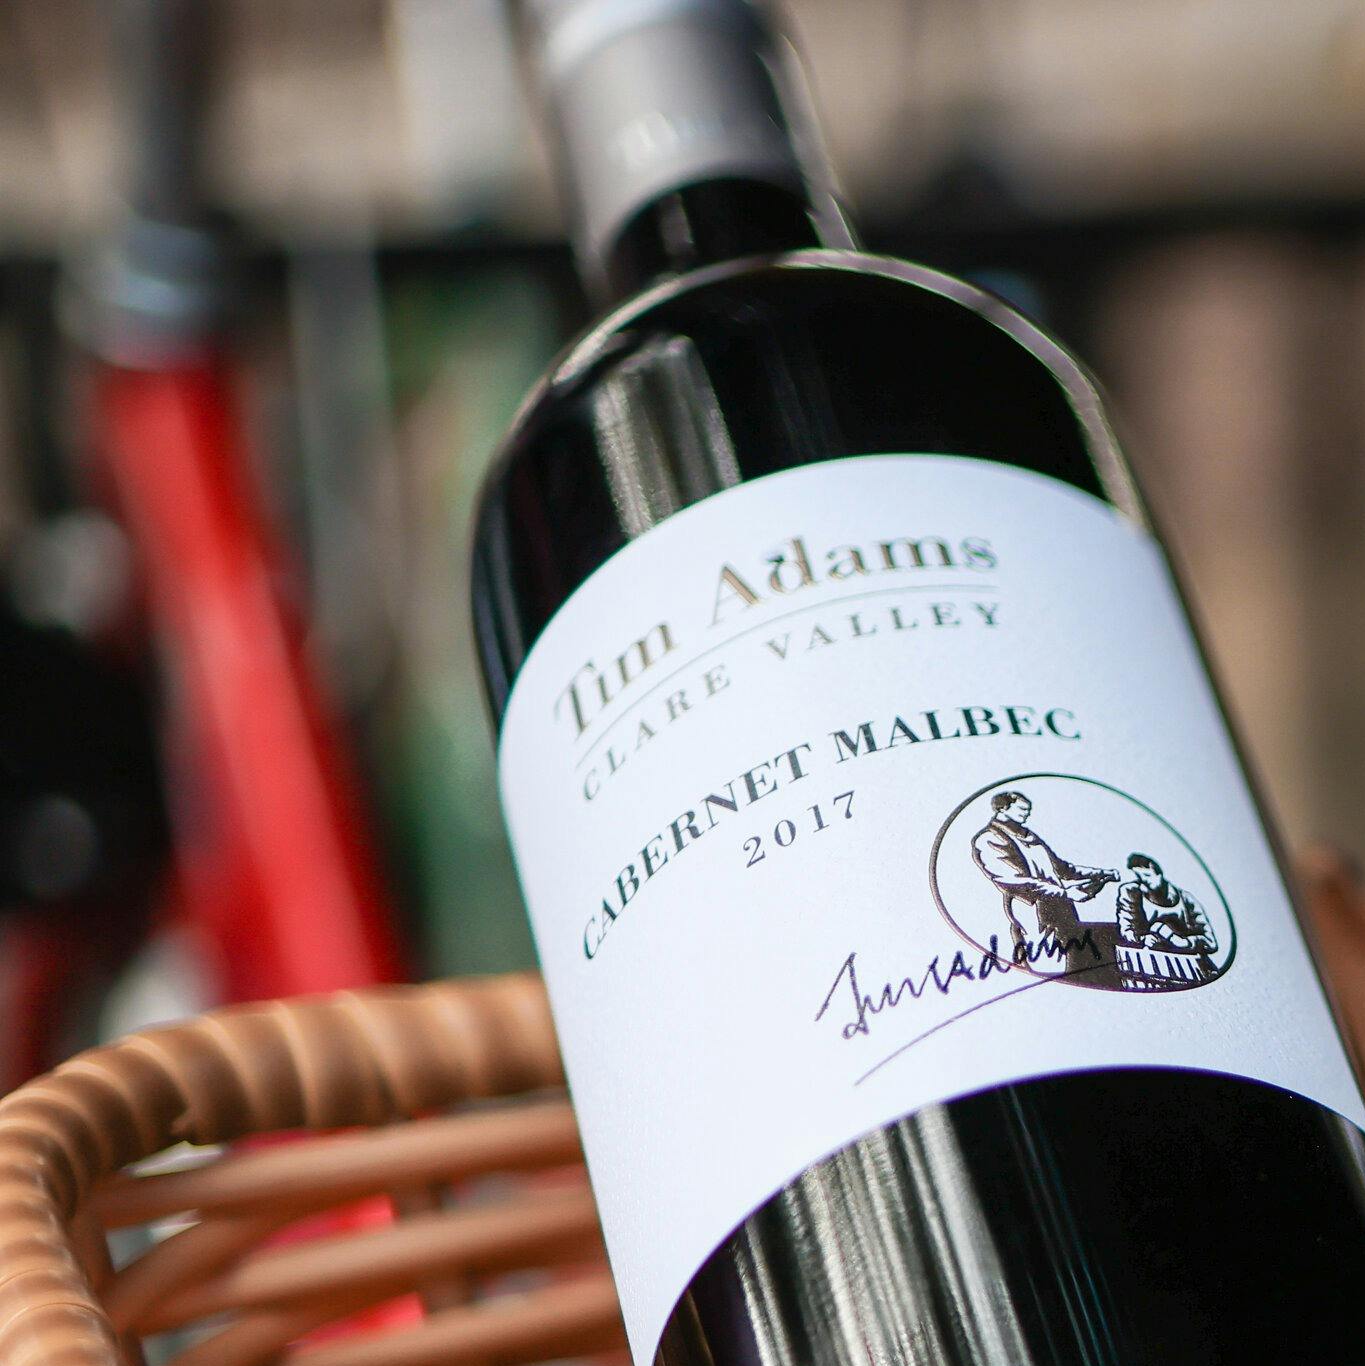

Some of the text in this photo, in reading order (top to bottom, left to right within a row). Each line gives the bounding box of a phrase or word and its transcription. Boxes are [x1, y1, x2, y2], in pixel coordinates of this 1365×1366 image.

[554, 535, 998, 743] Tim Adams
[582, 602, 1003, 802] CLARE VALLEY
[583, 706, 1083, 961] CABERNET MALBEC
[743, 790, 855, 868] 2017
